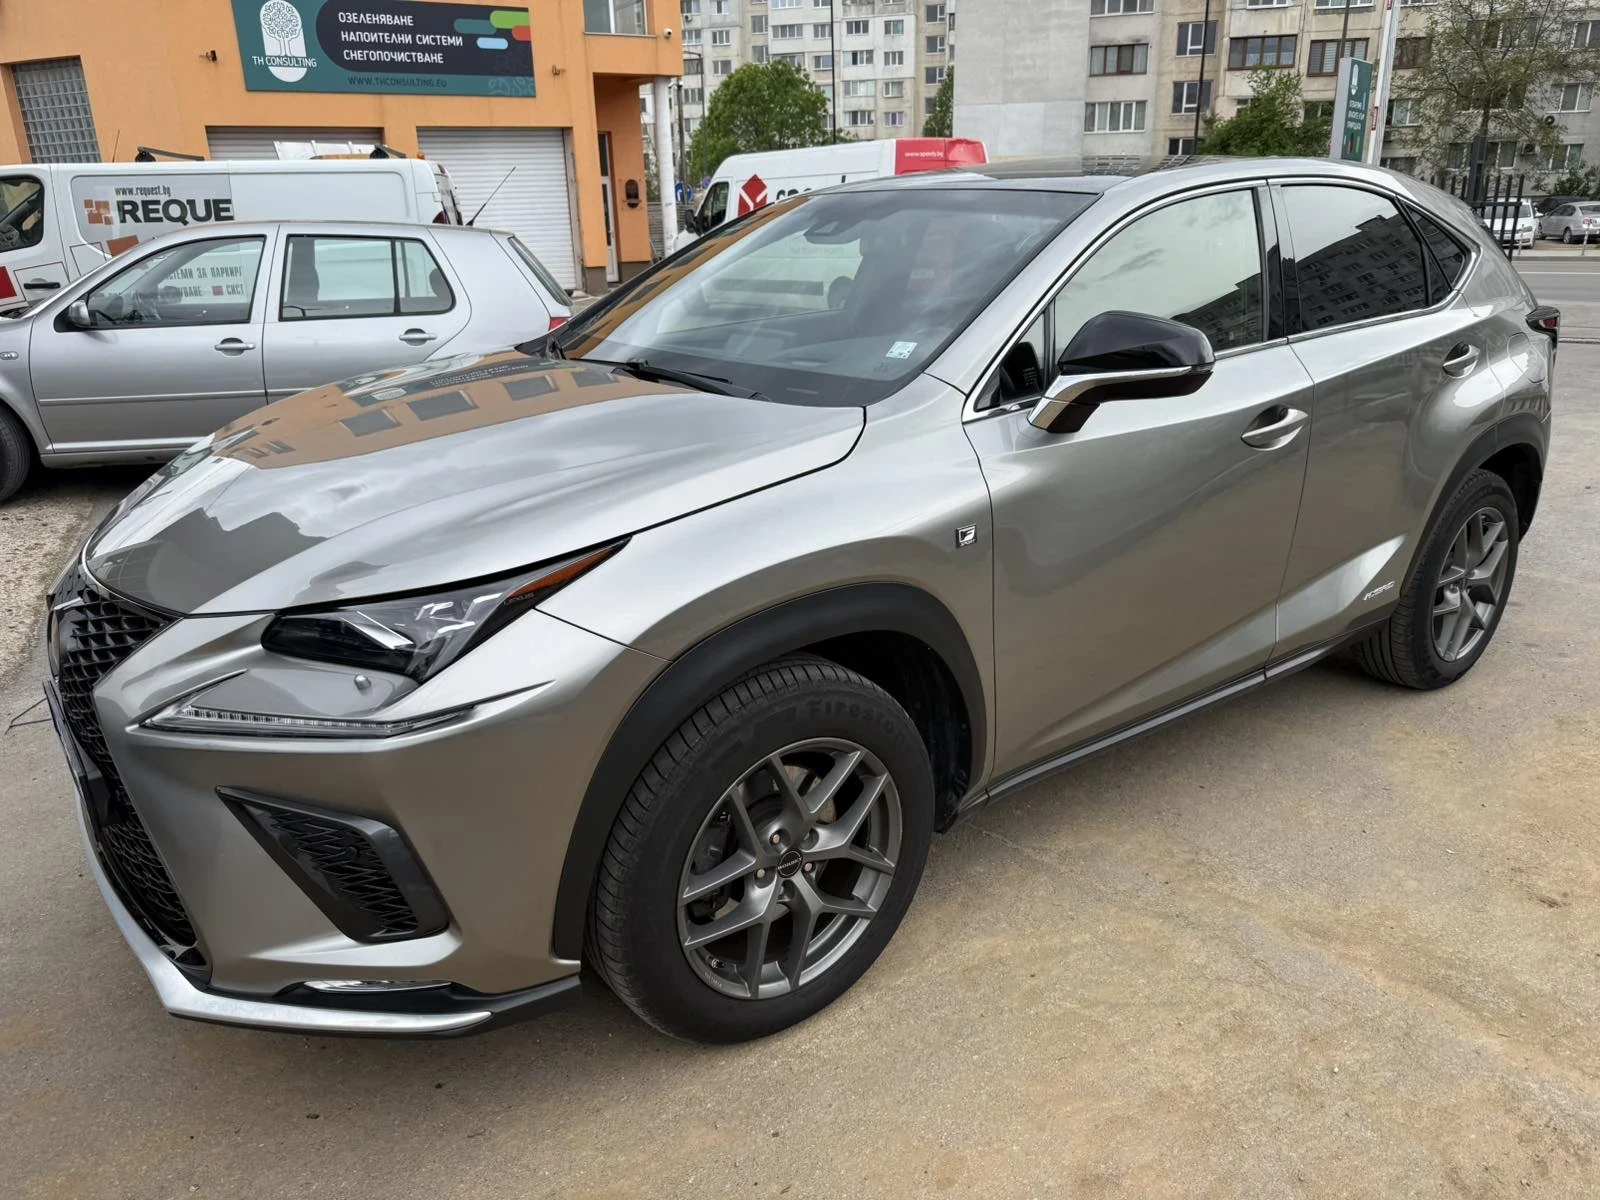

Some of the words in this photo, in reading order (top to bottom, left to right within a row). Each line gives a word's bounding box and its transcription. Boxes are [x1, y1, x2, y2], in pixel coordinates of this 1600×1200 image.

[338, 12, 414, 26] ОЗЕЛЕНЯВАНЕ
[341, 30, 412, 45] НАПОИТЕЛНИ
[416, 34, 463, 47] СИСТЕМИ
[252, 56, 264, 67] TH
[266, 56, 317, 68] CONSULTING
[343, 49, 444, 64] СНЕГОПОЧИСТВАНЕ
[347, 76, 447, 88] WWW.THCONSULTING.EU
[114, 185, 171, 197] www.request.bg
[196, 267, 208, 279] ЗА
